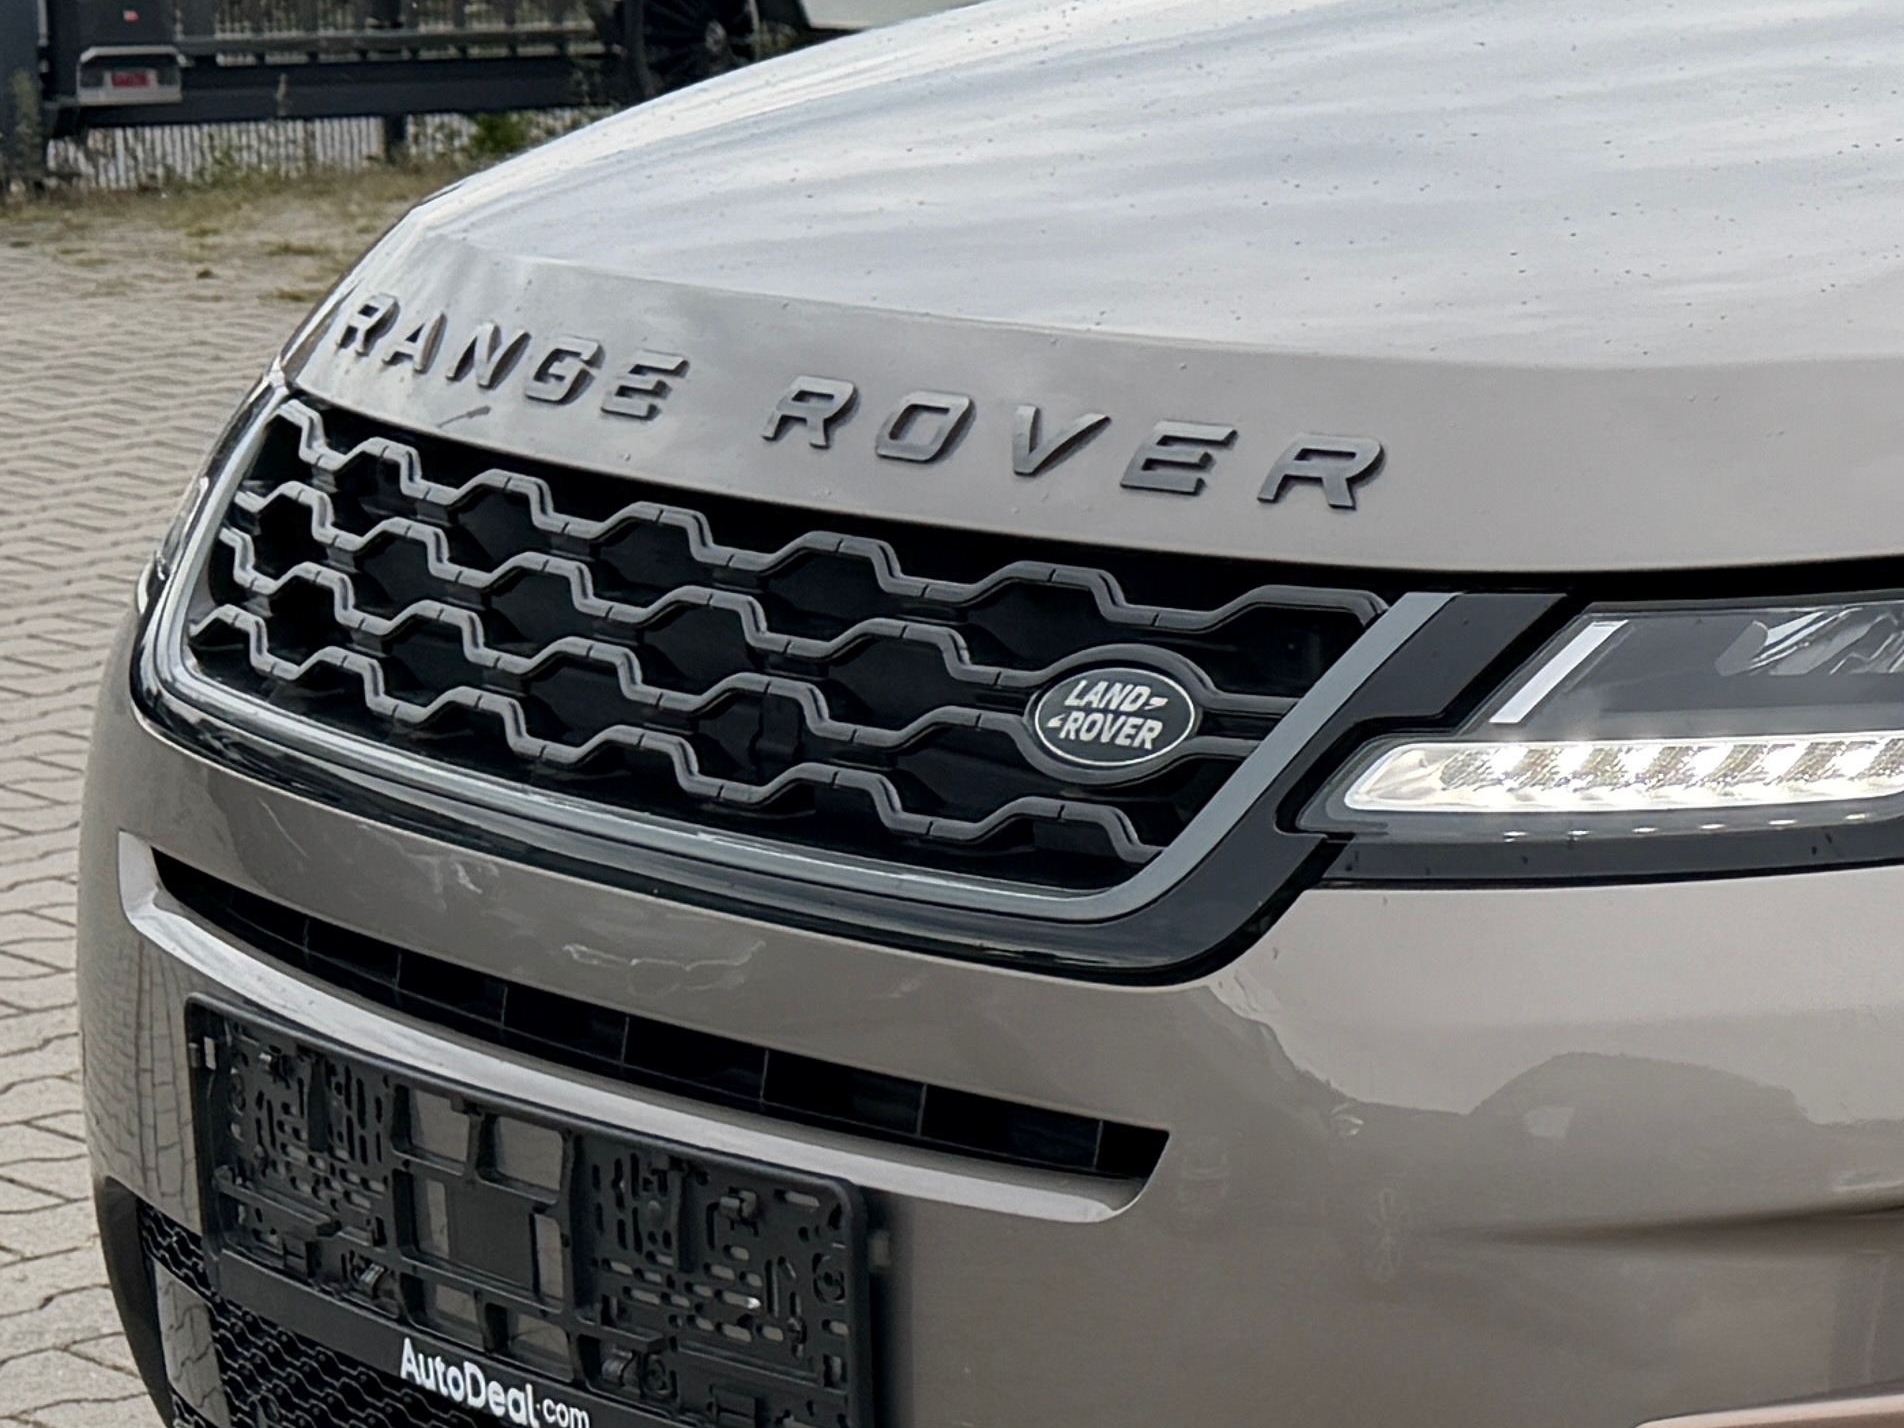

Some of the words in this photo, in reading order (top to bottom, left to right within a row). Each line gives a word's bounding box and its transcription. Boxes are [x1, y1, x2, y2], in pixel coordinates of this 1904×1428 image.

[335, 291, 690, 421] RANGE
[760, 374, 1390, 510] ROVER
[1058, 710, 1163, 750] ROVER
